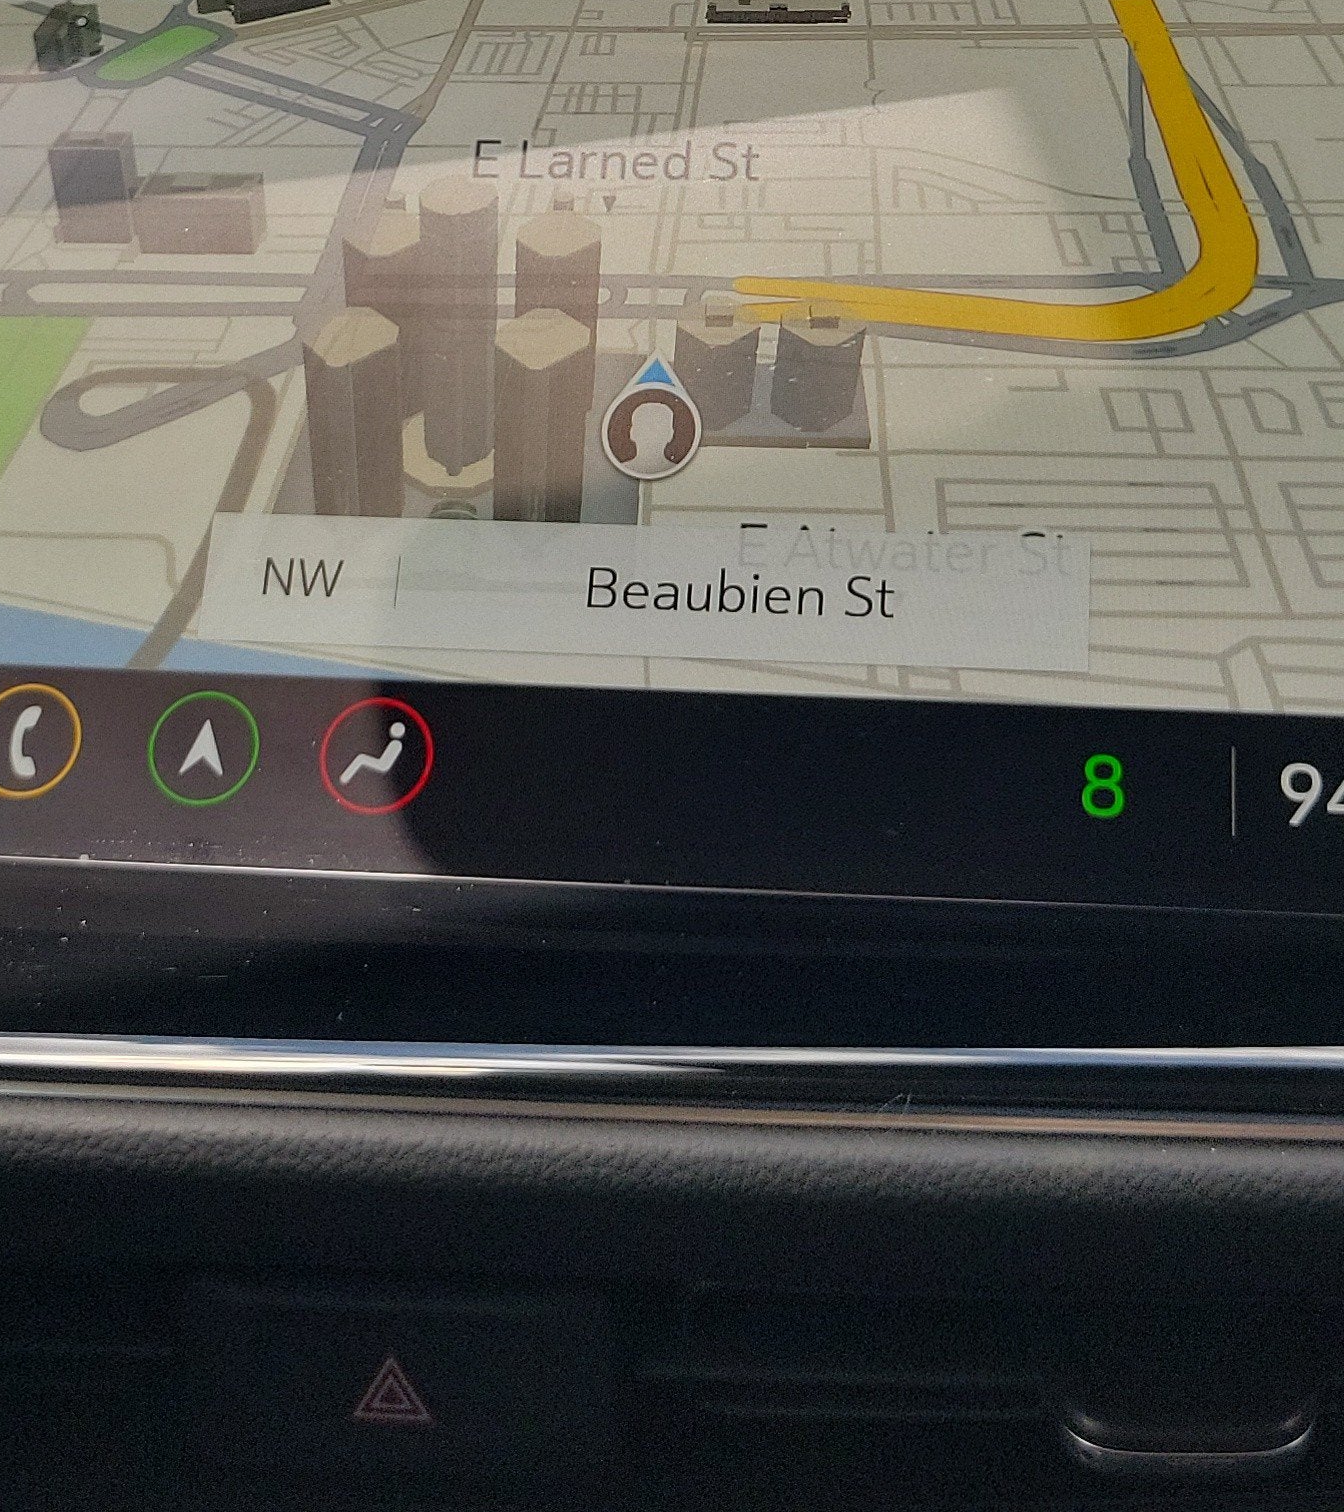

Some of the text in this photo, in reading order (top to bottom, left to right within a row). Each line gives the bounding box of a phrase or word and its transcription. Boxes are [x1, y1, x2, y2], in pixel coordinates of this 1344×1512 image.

[471, 140, 761, 181] E Larned St
[783, 524, 998, 575] Atwater
[1018, 530, 1072, 576] St
[260, 555, 344, 599] NW
[585, 565, 896, 620] Beaubien St
[1081, 753, 1125, 818] 8
